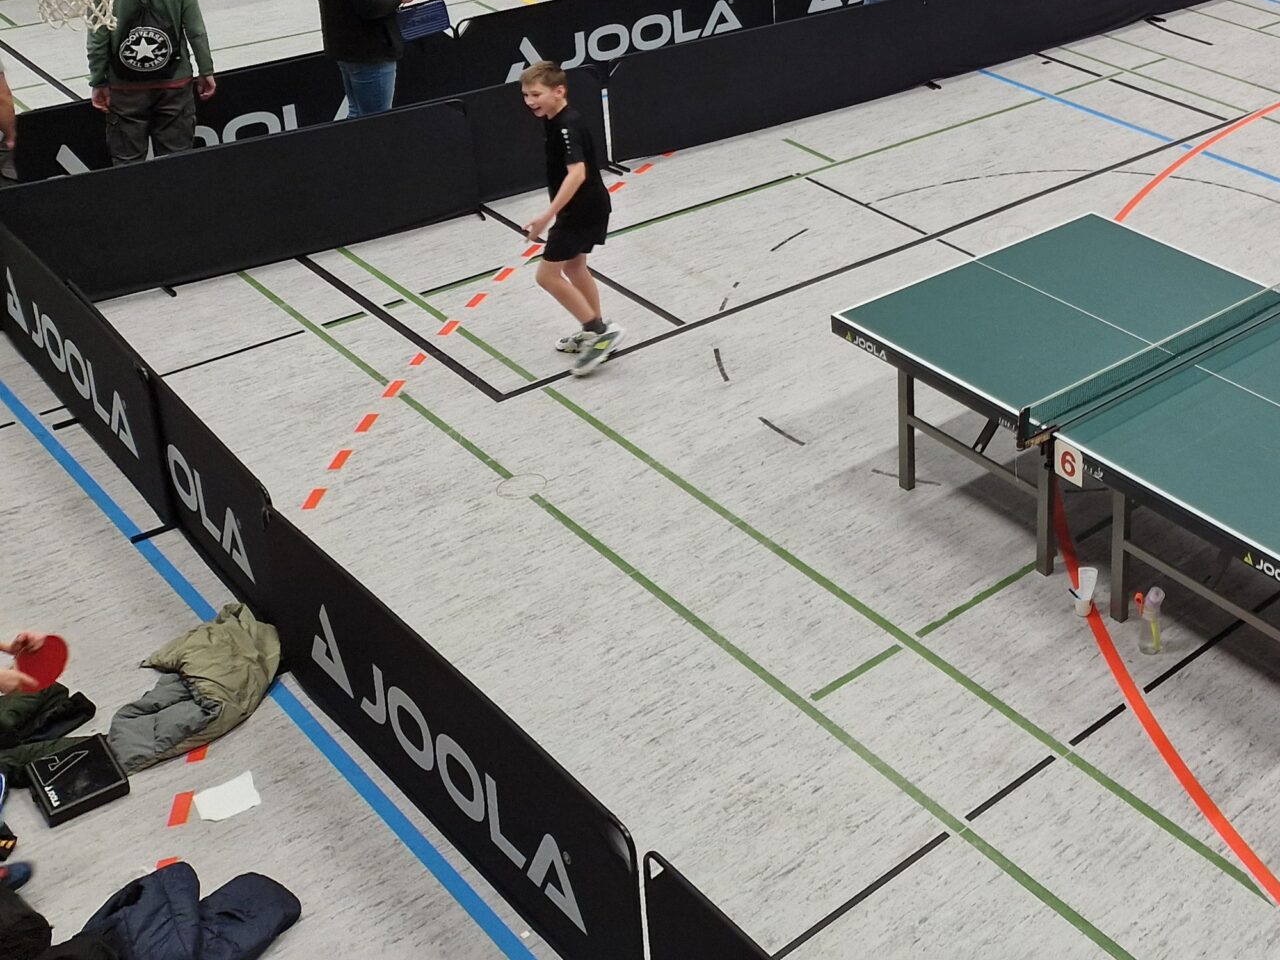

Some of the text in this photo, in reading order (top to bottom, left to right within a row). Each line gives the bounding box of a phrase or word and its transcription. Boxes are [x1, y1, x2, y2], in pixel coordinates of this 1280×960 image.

[560, 0, 743, 70] JOOLA
[127, 56, 165, 68] ALL STAR
[853, 335, 887, 361] JOOLA
[32, 301, 140, 460] JOOLA
[1060, 451, 1077, 477] 6
[360, 663, 588, 935] JOOLA
